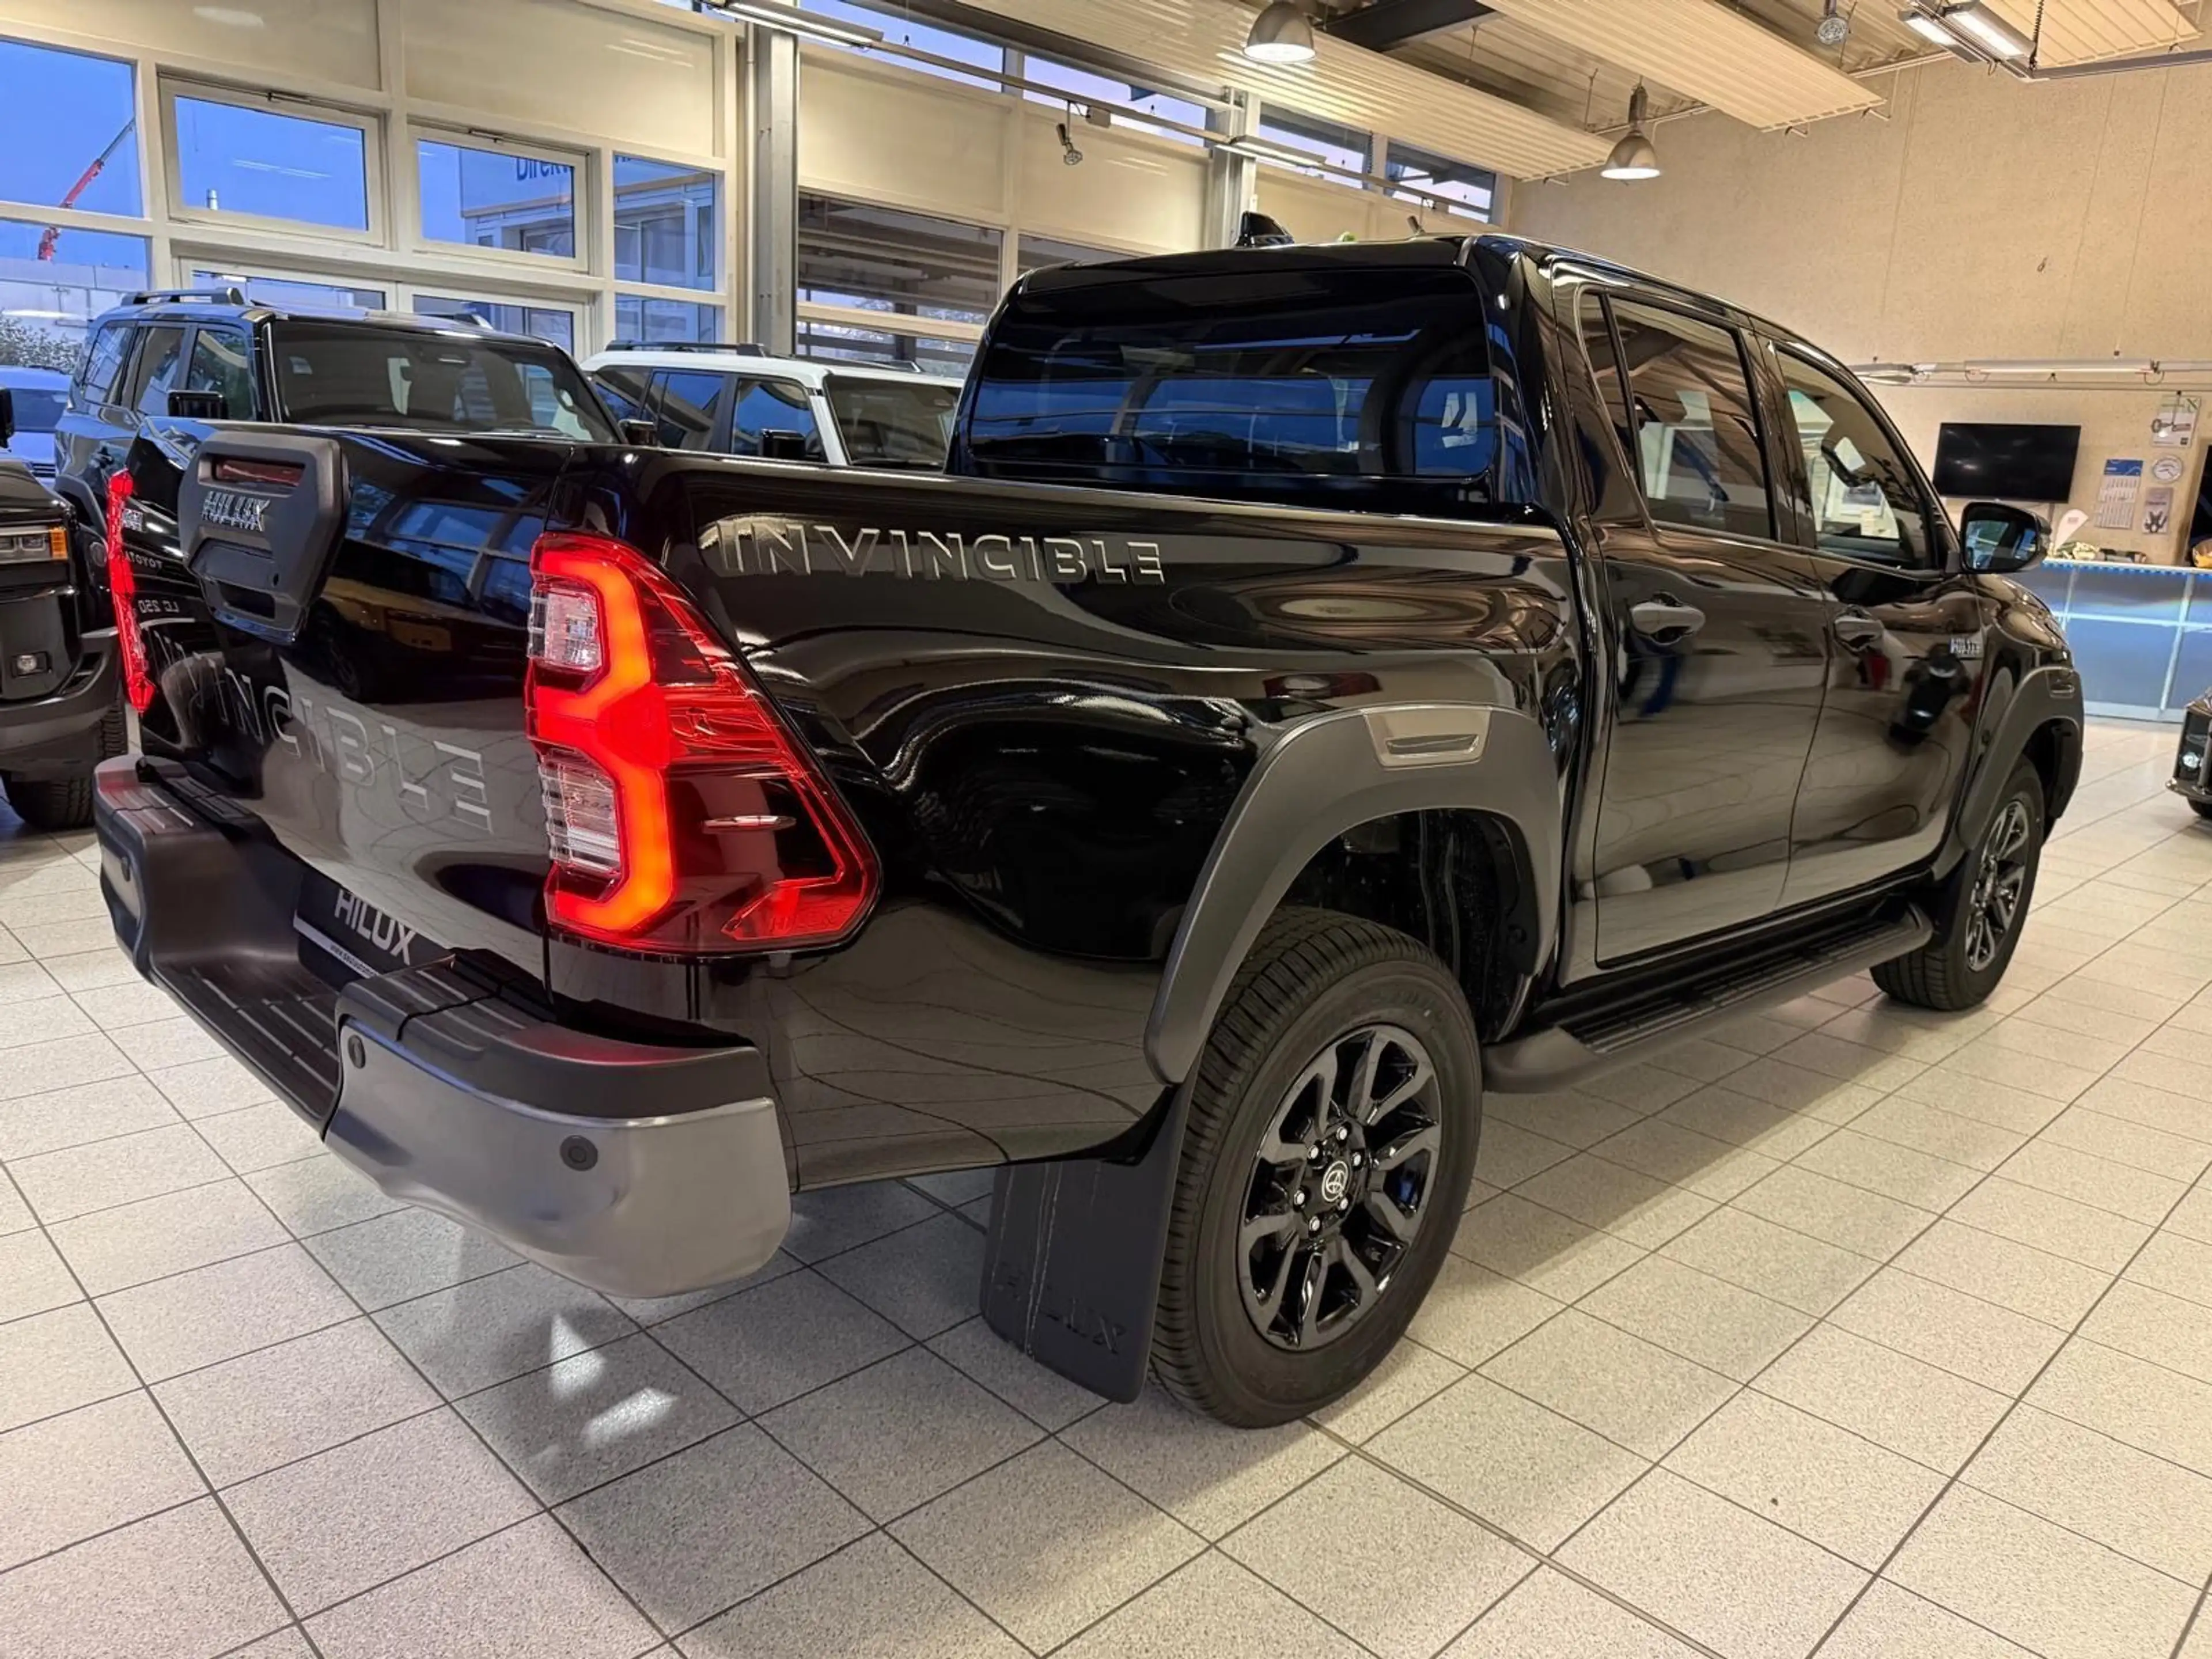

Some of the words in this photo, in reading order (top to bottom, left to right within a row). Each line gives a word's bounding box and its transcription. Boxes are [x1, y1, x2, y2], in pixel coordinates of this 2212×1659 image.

[201, 491, 271, 532] HILUX
[714, 518, 1165, 584] INVINCIBLE
[334, 888, 416, 966] HILUX
